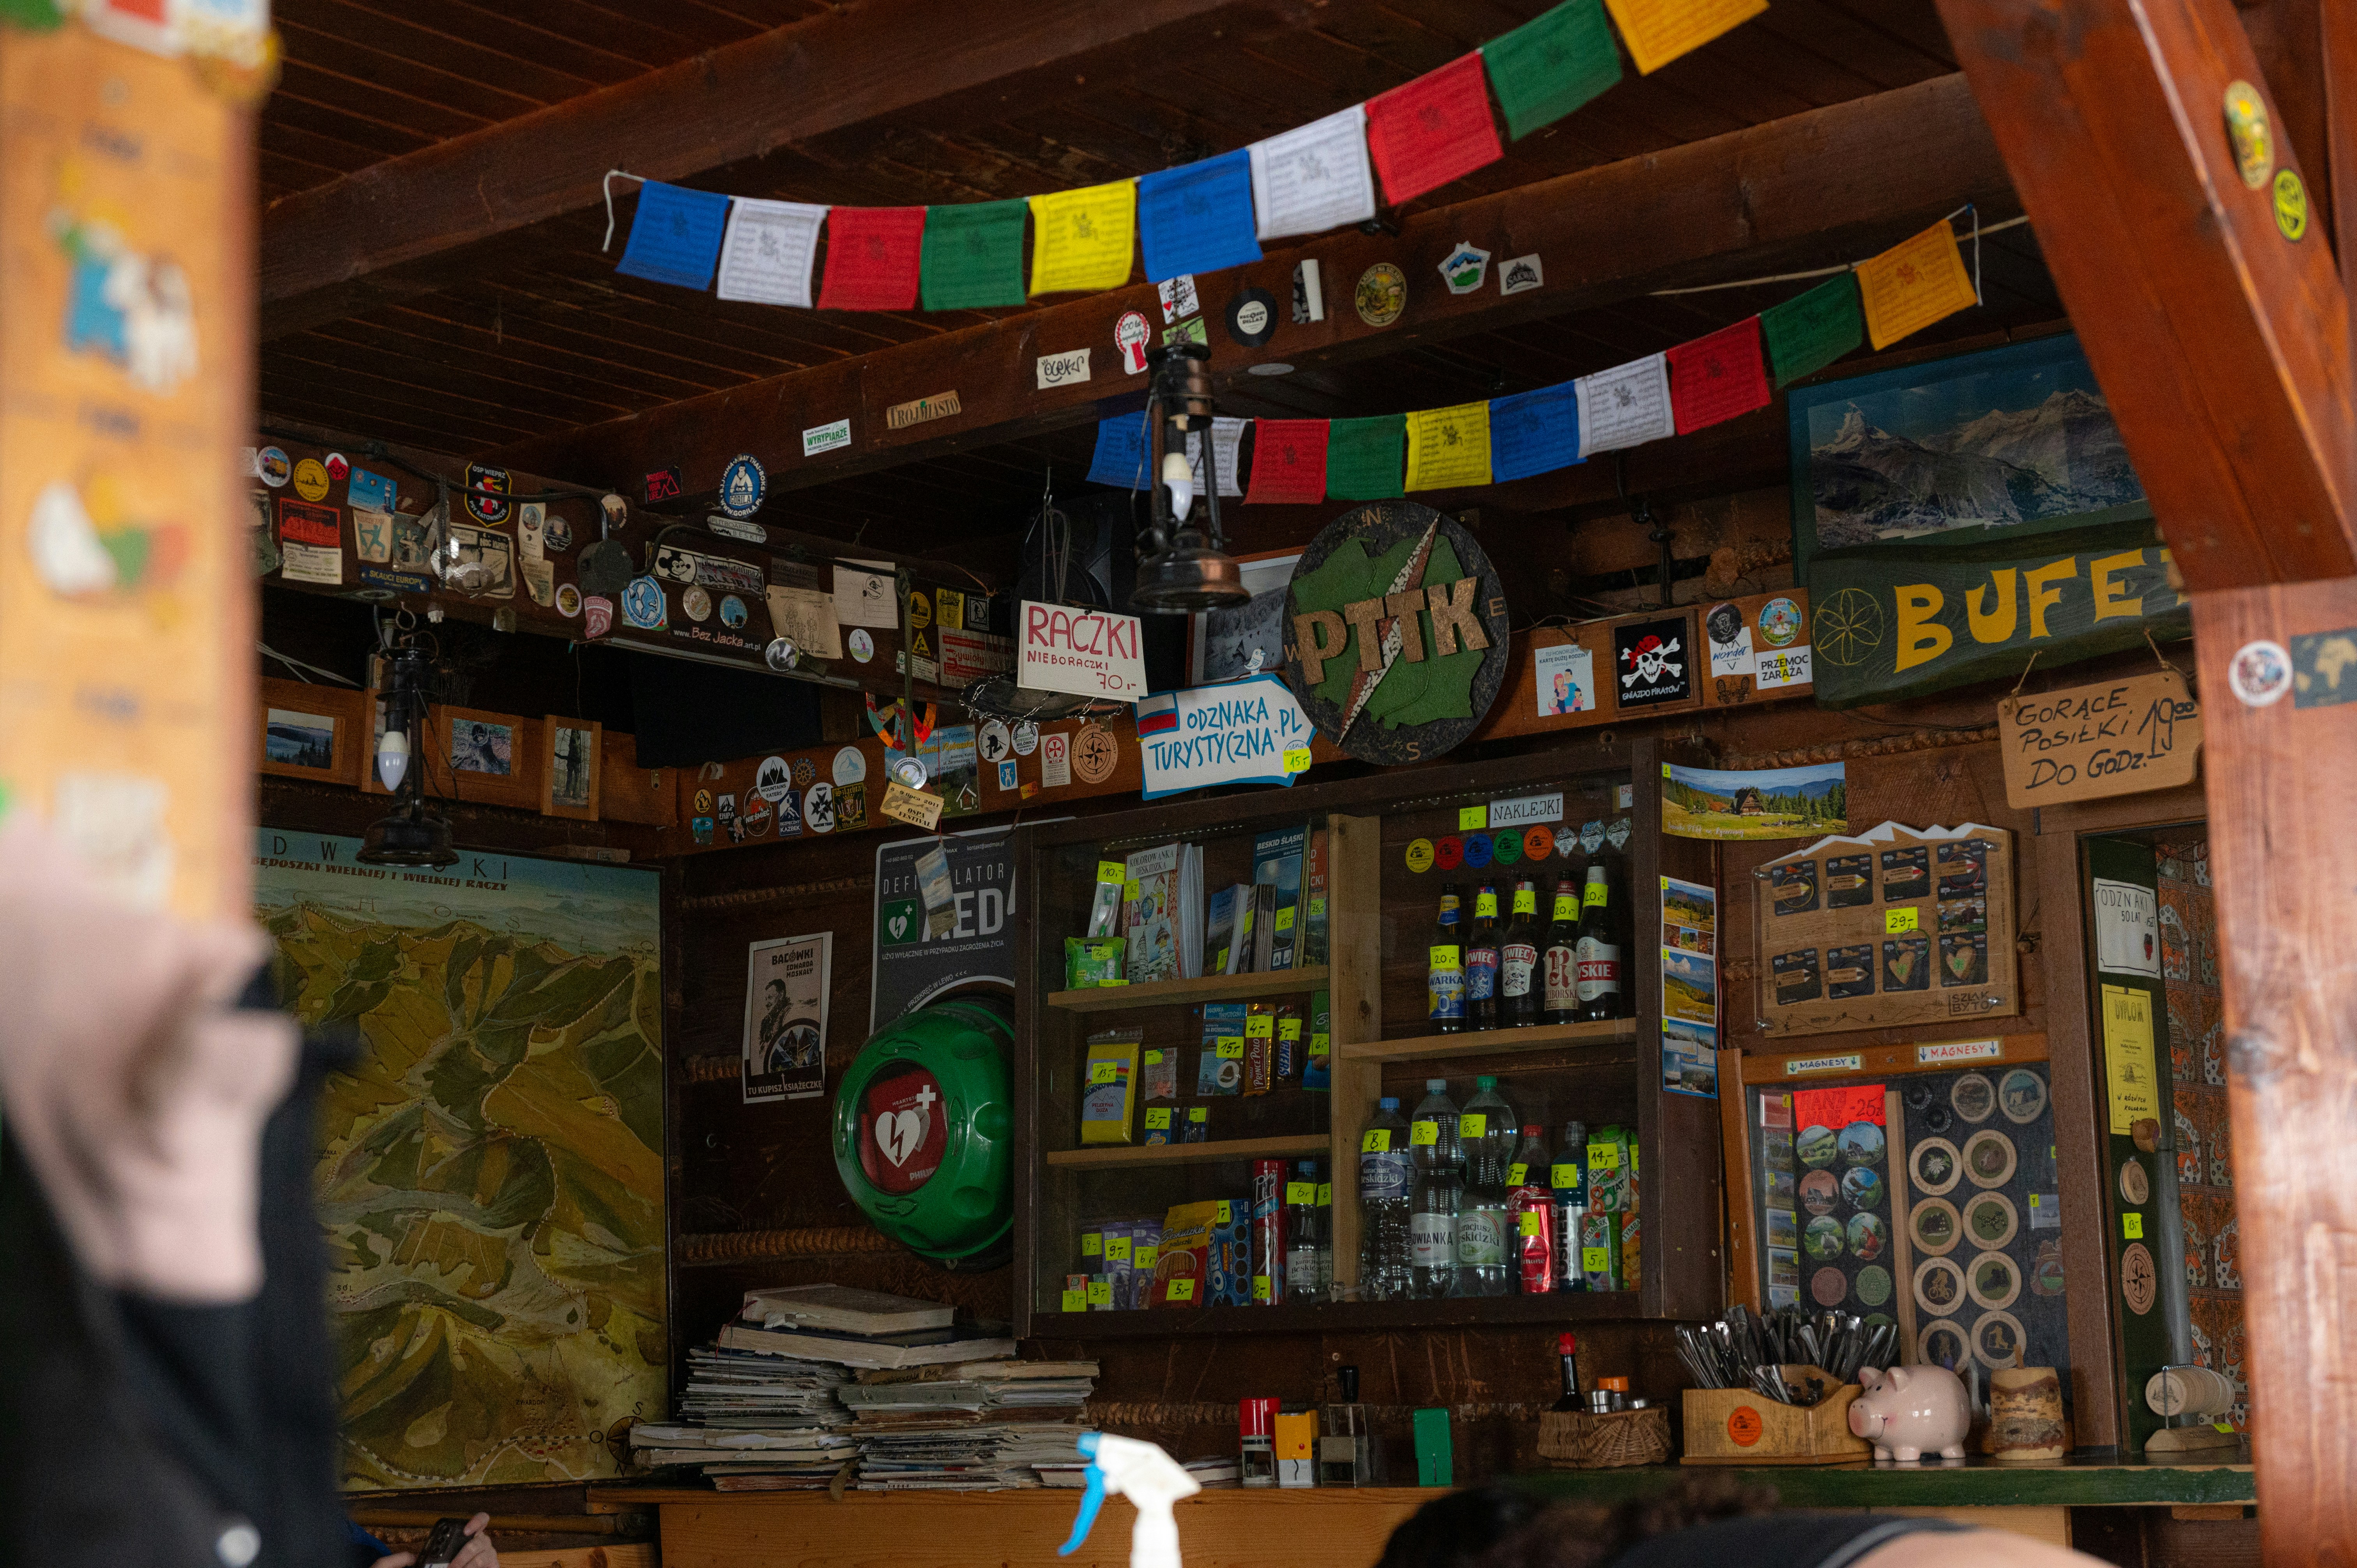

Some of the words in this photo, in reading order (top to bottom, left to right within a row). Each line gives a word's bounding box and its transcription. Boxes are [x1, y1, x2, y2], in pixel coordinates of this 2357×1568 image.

[891, 397, 959, 427] TRÓJMIASTO
[806, 427, 848, 447] WYRYPIARZE
[472, 465, 484, 474] OSP
[484, 468, 506, 479] WIEPRZ
[720, 497, 763, 516] WWW.GORILA.PL
[729, 495, 753, 505] GORILA
[469, 500, 477, 511] PSY
[476, 507, 507, 521] RATOWNICZE
[1363, 507, 1382, 527] N
[708, 516, 748, 531] SPLITBOARD
[732, 530, 764, 542] BESKID
[369, 570, 395, 581] SKAUCI
[396, 575, 422, 586] EUROPY
[1488, 597, 1505, 617] E
[1027, 605, 1138, 659] RACZKI
[1293, 576, 1489, 685] PTTK
[1284, 645, 1302, 663] W
[1552, 646, 1581, 657] HONORUJEM
[1554, 654, 1568, 663] DUŻEJ
[1569, 652, 1588, 660] RODZINY
[1027, 650, 1109, 671] NIEBORACZKI
[1761, 655, 1809, 671] PRZEMOC
[1762, 666, 1803, 682] ZARAŻA
[1187, 696, 1269, 731] ODZNAKA
[947, 731, 974, 740] Turystyczny
[1080, 725, 1099, 738] ZNACZEK
[1406, 742, 1421, 761] S
[2025, 758, 2076, 789] DO
[761, 784, 787, 793] MOUNTAINS
[905, 793, 921, 802] lipca
[923, 800, 940, 808] 2011
[1493, 798, 1561, 820] NAKLEJKI
[898, 811, 931, 828] FESTIVAL
[907, 808, 926, 819] OSPA
[966, 840, 1005, 851] kontakt@aedmax.pl
[1257, 839, 1280, 851] BESKID
[1281, 833, 1304, 846] ŚLĄSKI
[1130, 850, 1174, 867] KOLOROWANKA
[1136, 862, 1166, 876] BESKIDZKA
[325, 864, 386, 880] WIELKIEJ
[391, 871, 397, 880] I
[403, 872, 461, 888] WIELKIEJ
[465, 879, 508, 892] RACZY
[883, 863, 1004, 895] DEFILATOR
[2101, 889, 2148, 913] ODZNAKI
[772, 947, 813, 965] BACÓWKI
[882, 952, 894, 961] UŻYJ
[895, 949, 923, 959] WYŁĄCZNIE
[929, 945, 959, 955] PRZYPADKU
[959, 941, 990, 952] ZAGROŻENIA
[990, 939, 1004, 948] ŻYCIA
[1466, 952, 1494, 964] YWIEC
[786, 960, 813, 971] EDWARDA
[786, 968, 813, 978] MOSKAŁY
[1578, 964, 1612, 978] YSKIE
[1429, 975, 1465, 986] WARKA
[907, 984, 933, 1008] PRZEKRĘĆ
[938, 974, 953, 986] LEWO
[2115, 999, 2144, 1022] DYPLOM
[1249, 1038, 1260, 1060] POLO
[1930, 1044, 1986, 1058] MAGNESY
[1278, 1040, 1291, 1076] ICKERS
[1799, 1058, 1848, 1069] MAGNESY
[1254, 1059, 1264, 1086] PRINCE
[747, 1087, 757, 1095] TU
[758, 1084, 783, 1094] KUPISZ
[783, 1080, 823, 1092] KSIĄŻECZKĘ
[1361, 1173, 1399, 1184] eskidzki
[1159, 1225, 1206, 1245] Beskidzkie
[1209, 1232, 1225, 1292] OREO
